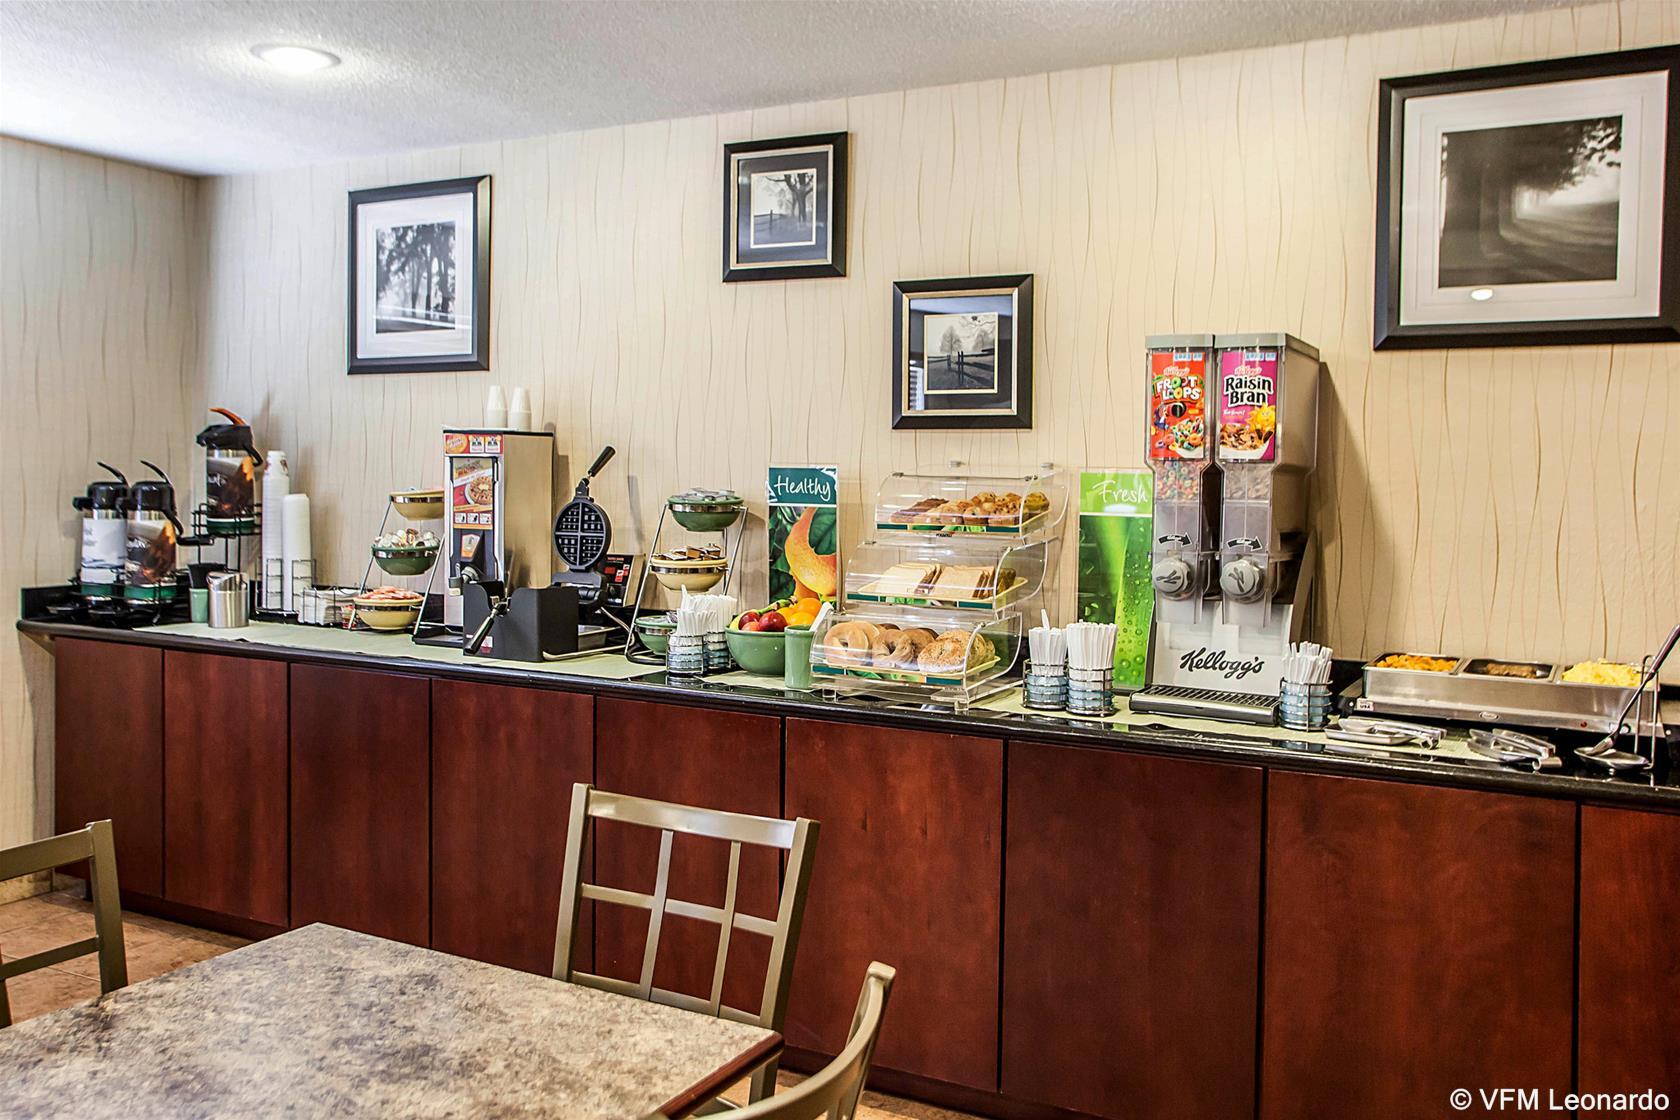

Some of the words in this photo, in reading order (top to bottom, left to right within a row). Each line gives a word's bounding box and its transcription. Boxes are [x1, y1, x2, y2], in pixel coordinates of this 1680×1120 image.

[1163, 387, 1200, 400] LOOPS
[1225, 376, 1272, 392] Raisin
[1230, 390, 1266, 405] Bran
[773, 474, 831, 502] Healthy
[1092, 479, 1148, 504] Fresh
[1179, 646, 1265, 680] Kellogg's
